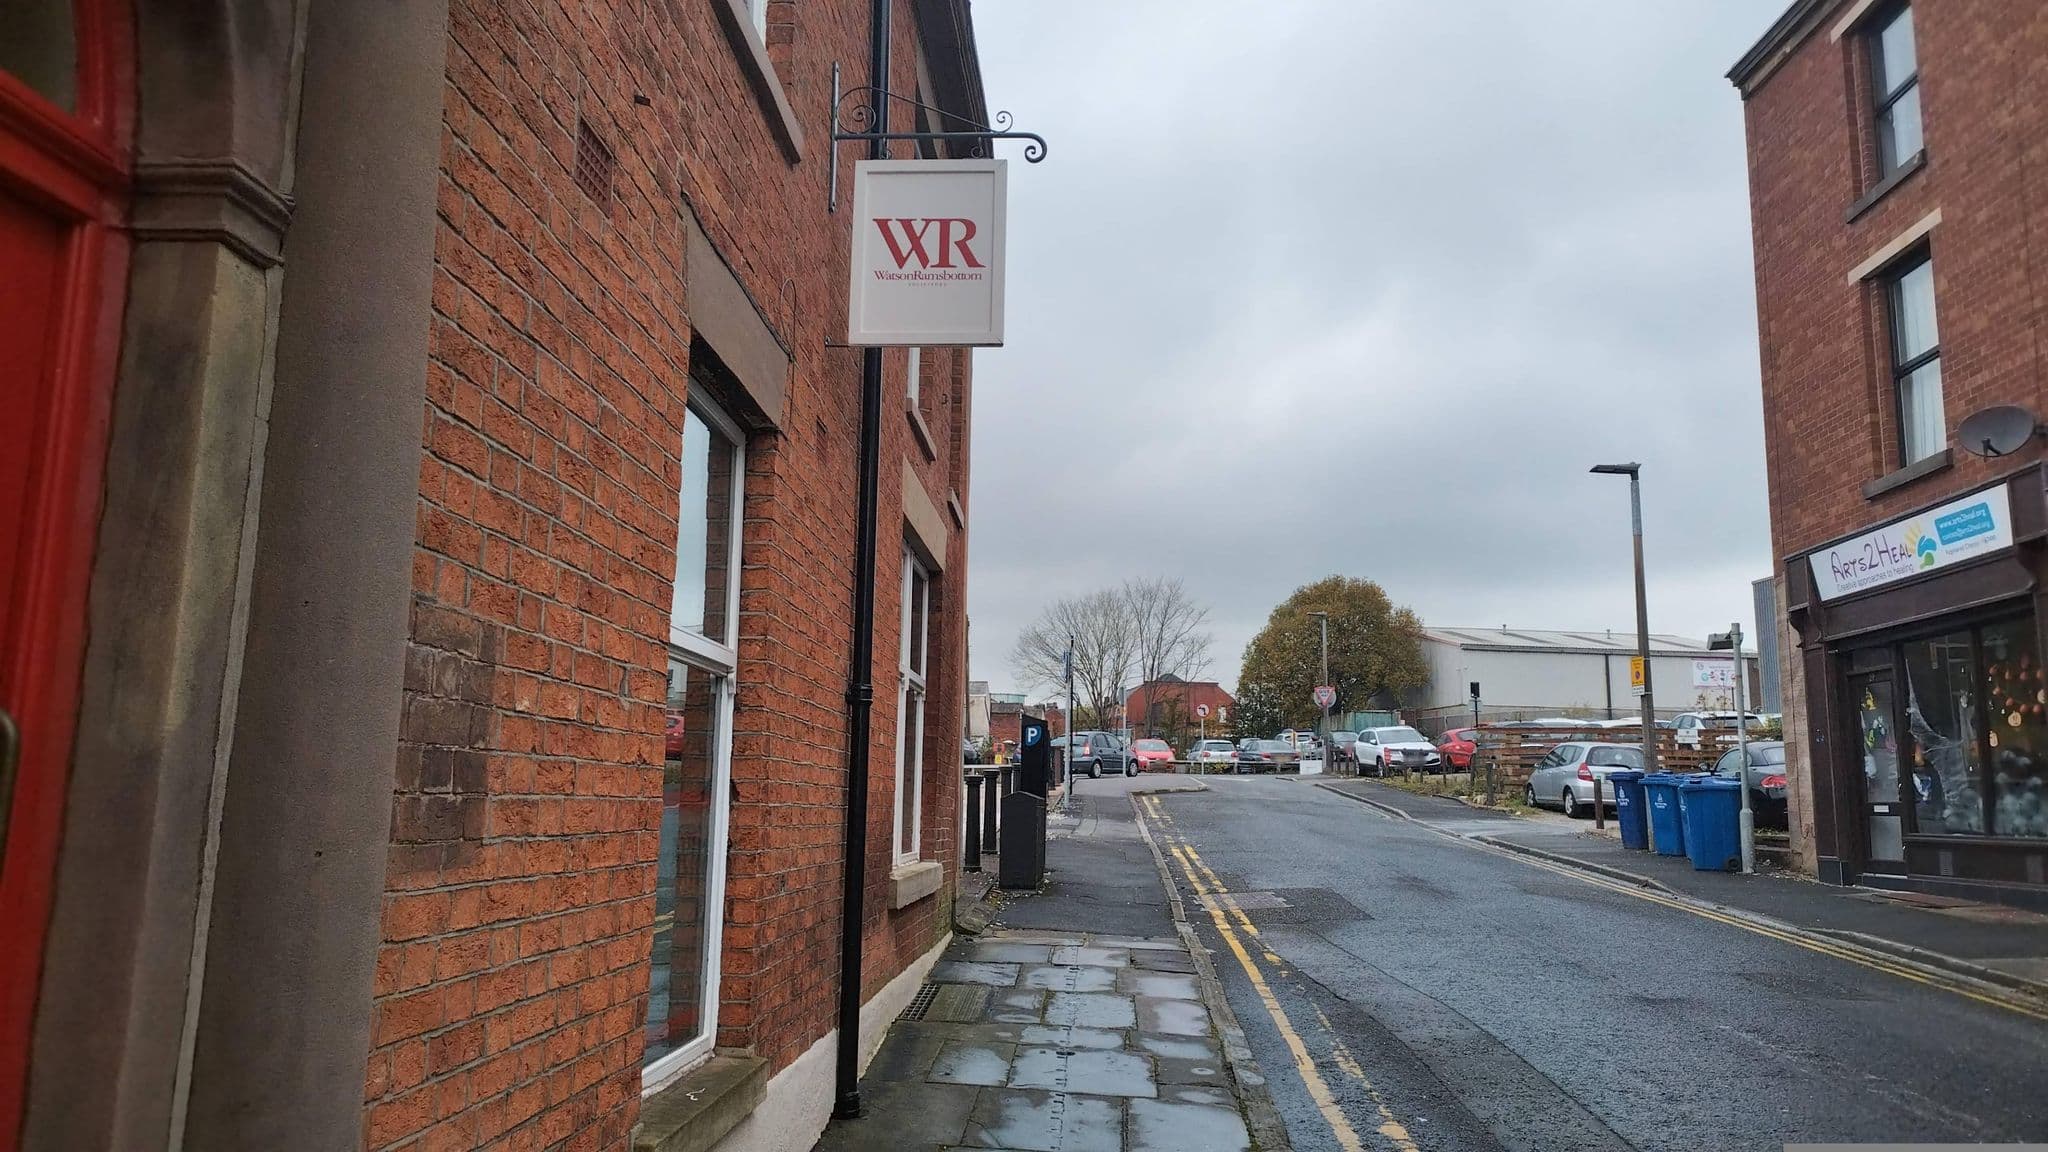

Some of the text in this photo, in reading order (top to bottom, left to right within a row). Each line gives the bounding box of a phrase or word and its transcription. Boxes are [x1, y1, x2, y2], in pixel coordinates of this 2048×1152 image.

[872, 217, 987, 270] WR
[874, 269, 982, 281] WatsonRamsbottom
[1027, 727, 1038, 743] P
